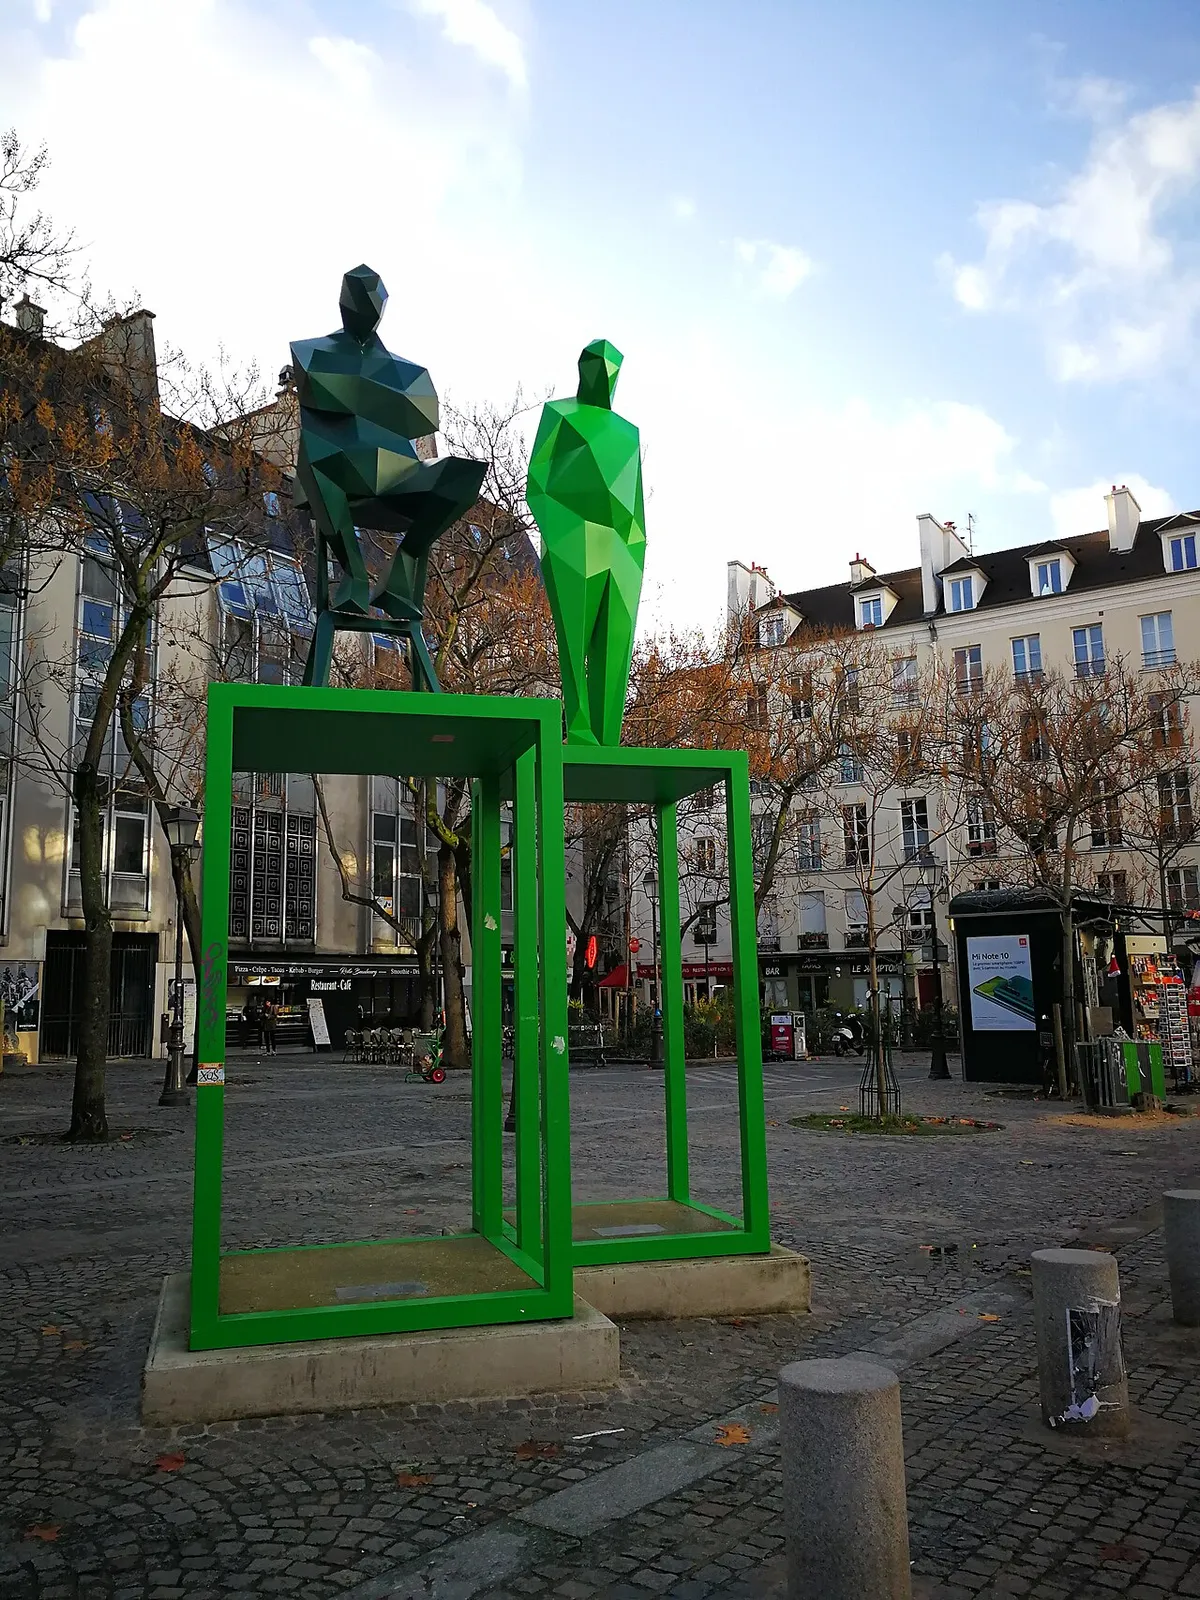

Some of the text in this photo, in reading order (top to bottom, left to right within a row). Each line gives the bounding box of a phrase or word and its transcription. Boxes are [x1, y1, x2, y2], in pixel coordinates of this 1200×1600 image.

[235, 965, 249, 973] Pizza
[270, 966, 285, 974] Tacos
[307, 967, 324, 975] Burger
[765, 966, 781, 976] BAR
[851, 964, 862, 973] LE
[310, 979, 352, 991] Restaurant Café
